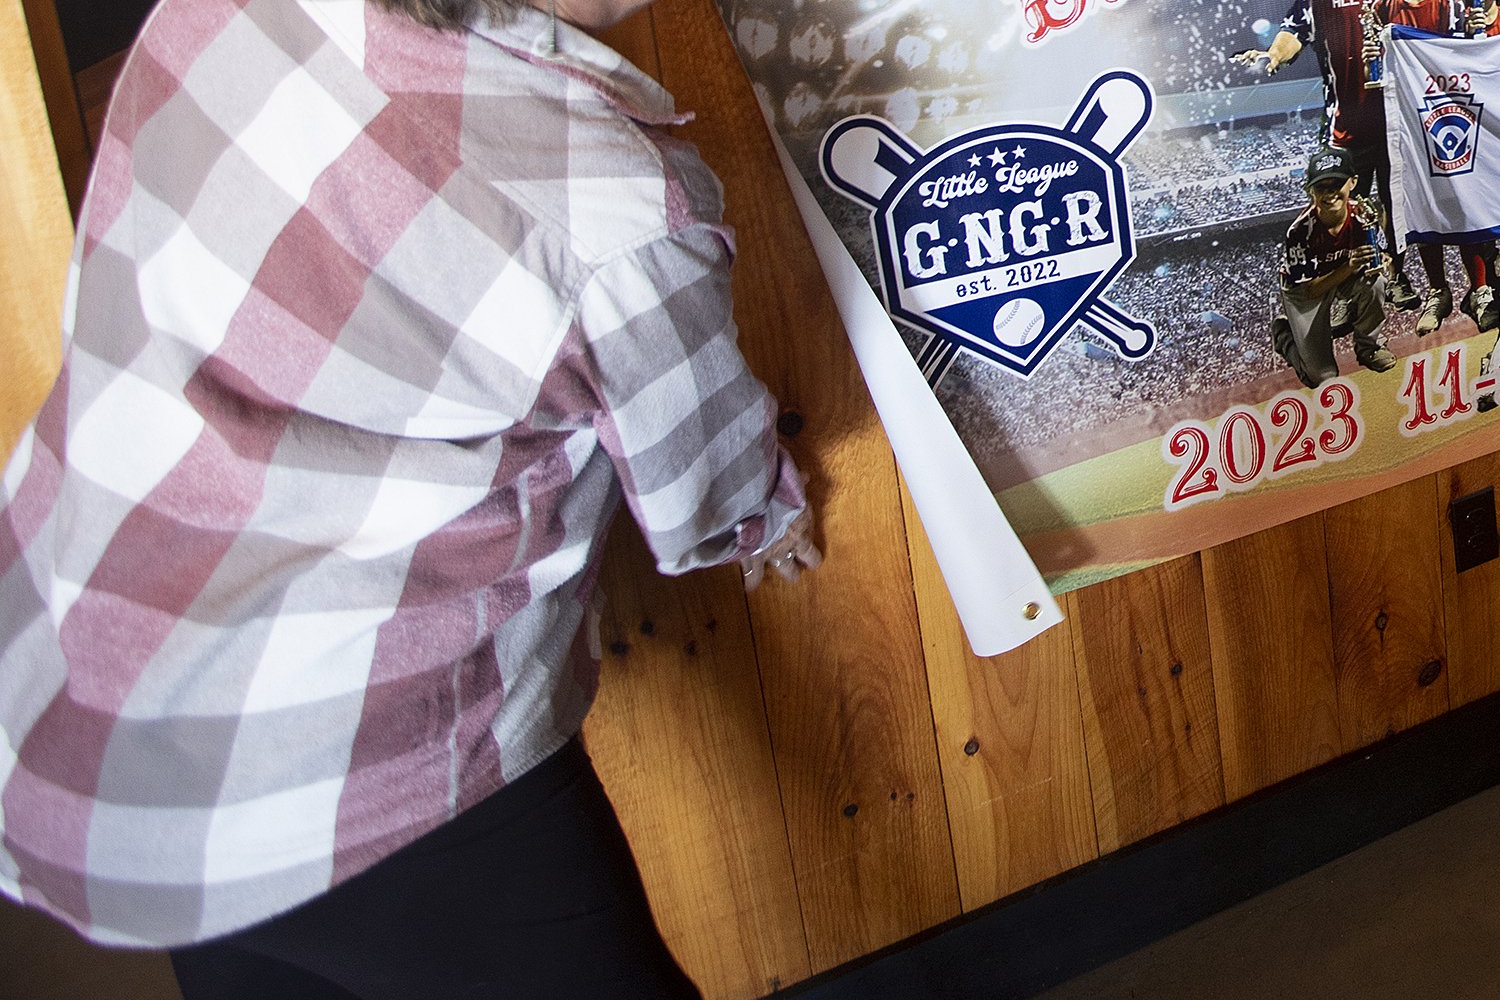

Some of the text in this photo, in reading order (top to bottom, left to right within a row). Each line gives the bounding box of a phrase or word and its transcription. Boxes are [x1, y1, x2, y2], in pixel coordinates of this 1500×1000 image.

[1424, 72, 1471, 95] 2023
[1425, 108, 1446, 127] LITTLE
[1435, 155, 1468, 170] BASEBALL
[918, 158, 1080, 208] Little League
[955, 259, 1061, 298] est. 2022
[1168, 382, 1359, 505] 2023
